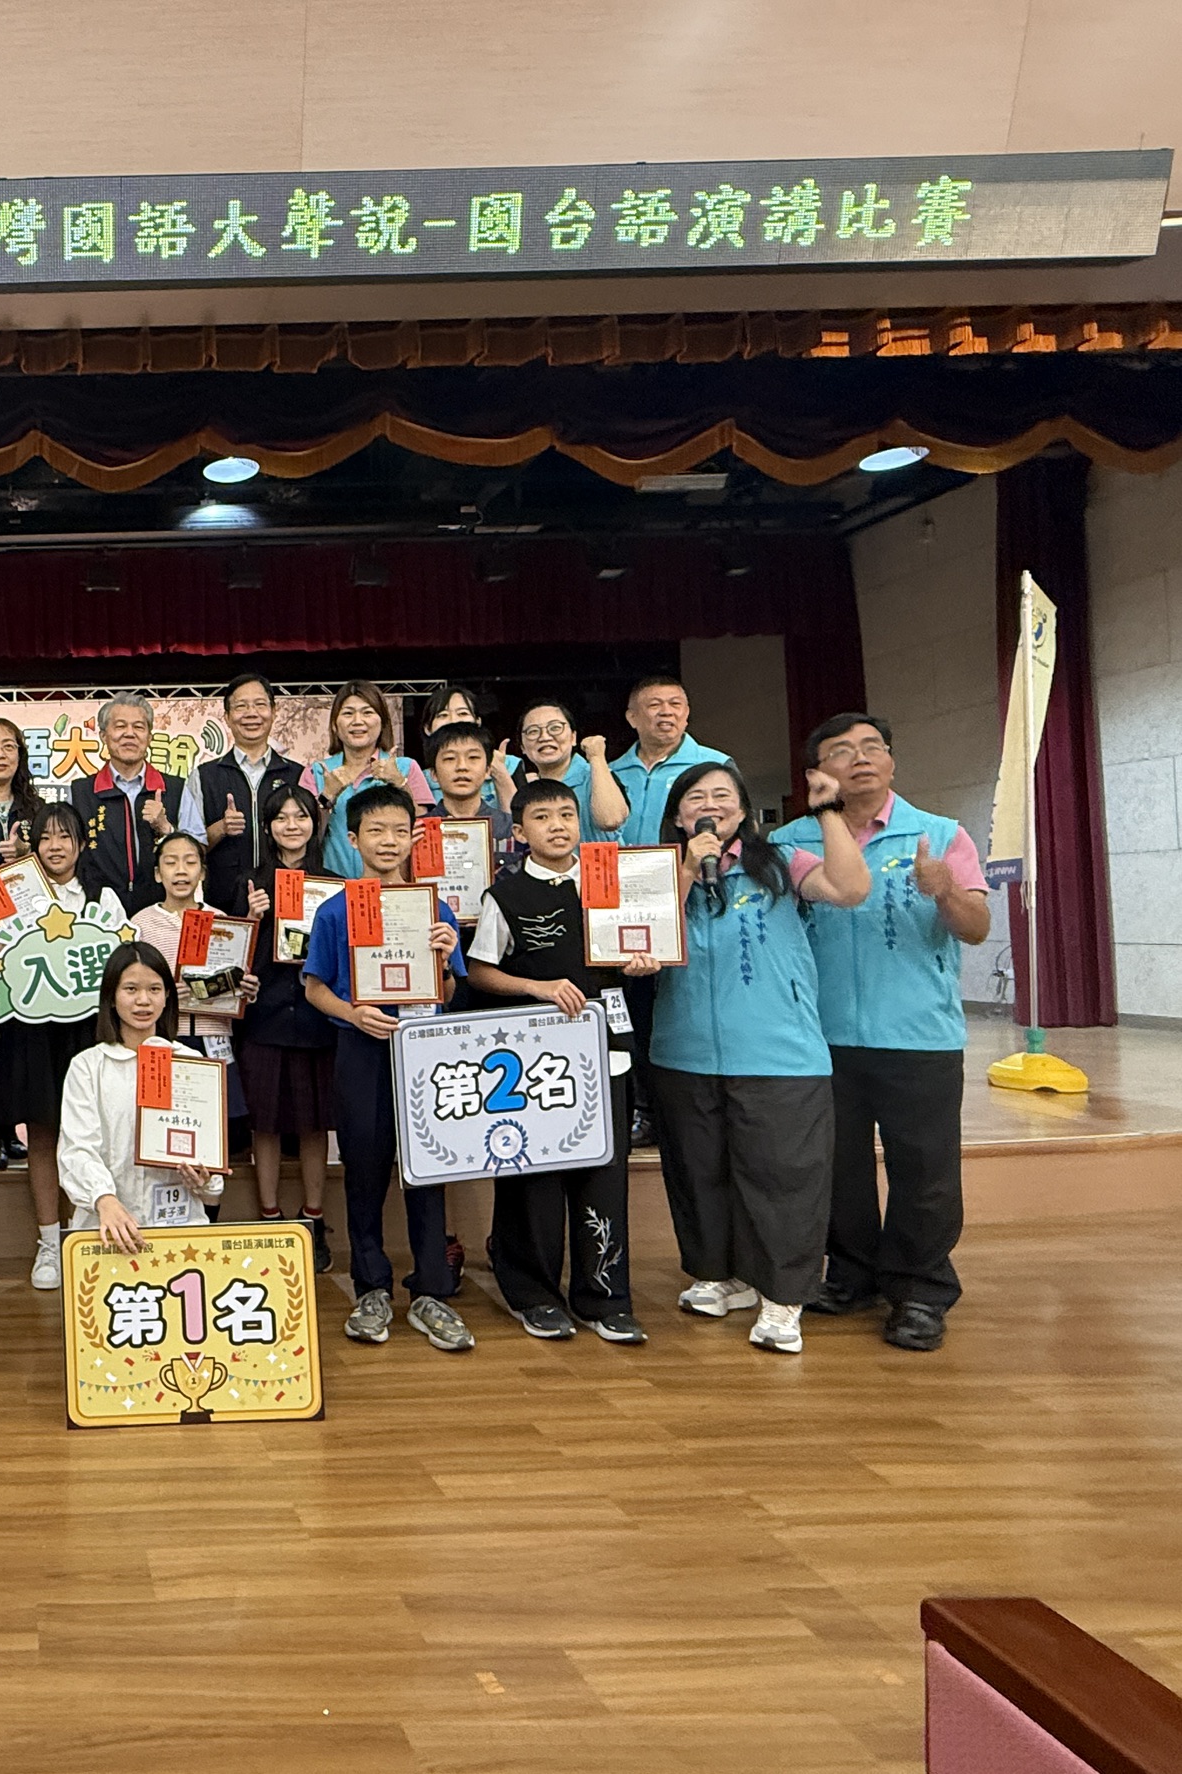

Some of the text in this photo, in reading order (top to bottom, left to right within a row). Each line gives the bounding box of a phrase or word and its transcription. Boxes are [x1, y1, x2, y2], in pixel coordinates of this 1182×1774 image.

[22, 943, 111, 1005] 入選
[611, 995, 621, 1009] 25
[431, 1049, 576, 1120] 第2名
[502, 1136, 511, 1146] 2
[166, 1189, 179, 1203] 19
[104, 1268, 276, 1348] 第1名
[191, 1377, 197, 1385] 1
